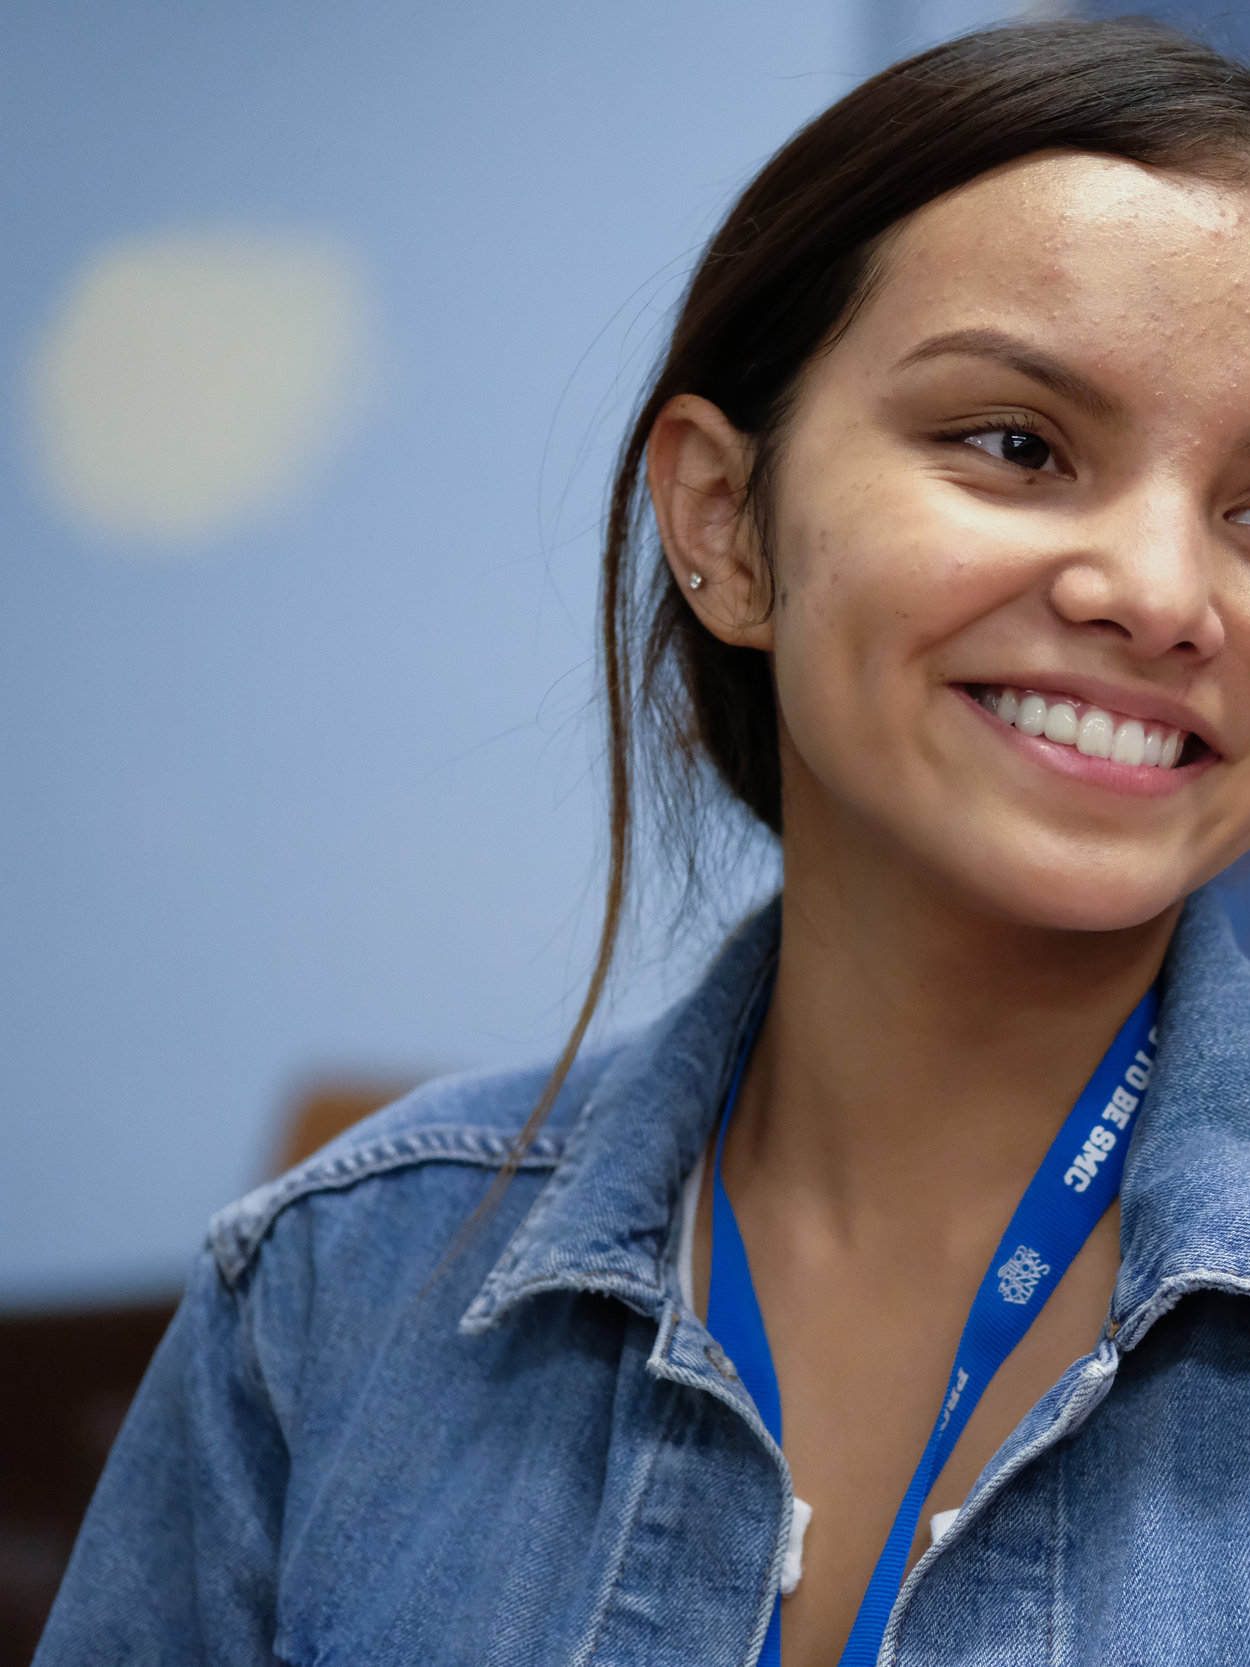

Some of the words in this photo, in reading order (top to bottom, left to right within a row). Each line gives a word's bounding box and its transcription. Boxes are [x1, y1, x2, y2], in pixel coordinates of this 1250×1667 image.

[1125, 1050, 1154, 1091] TO
[1101, 1085, 1139, 1130] BE
[1063, 1125, 1117, 1193] SMC
[1003, 1248, 1040, 1301] MONICA
[1013, 1259, 1051, 1304] SANTA
